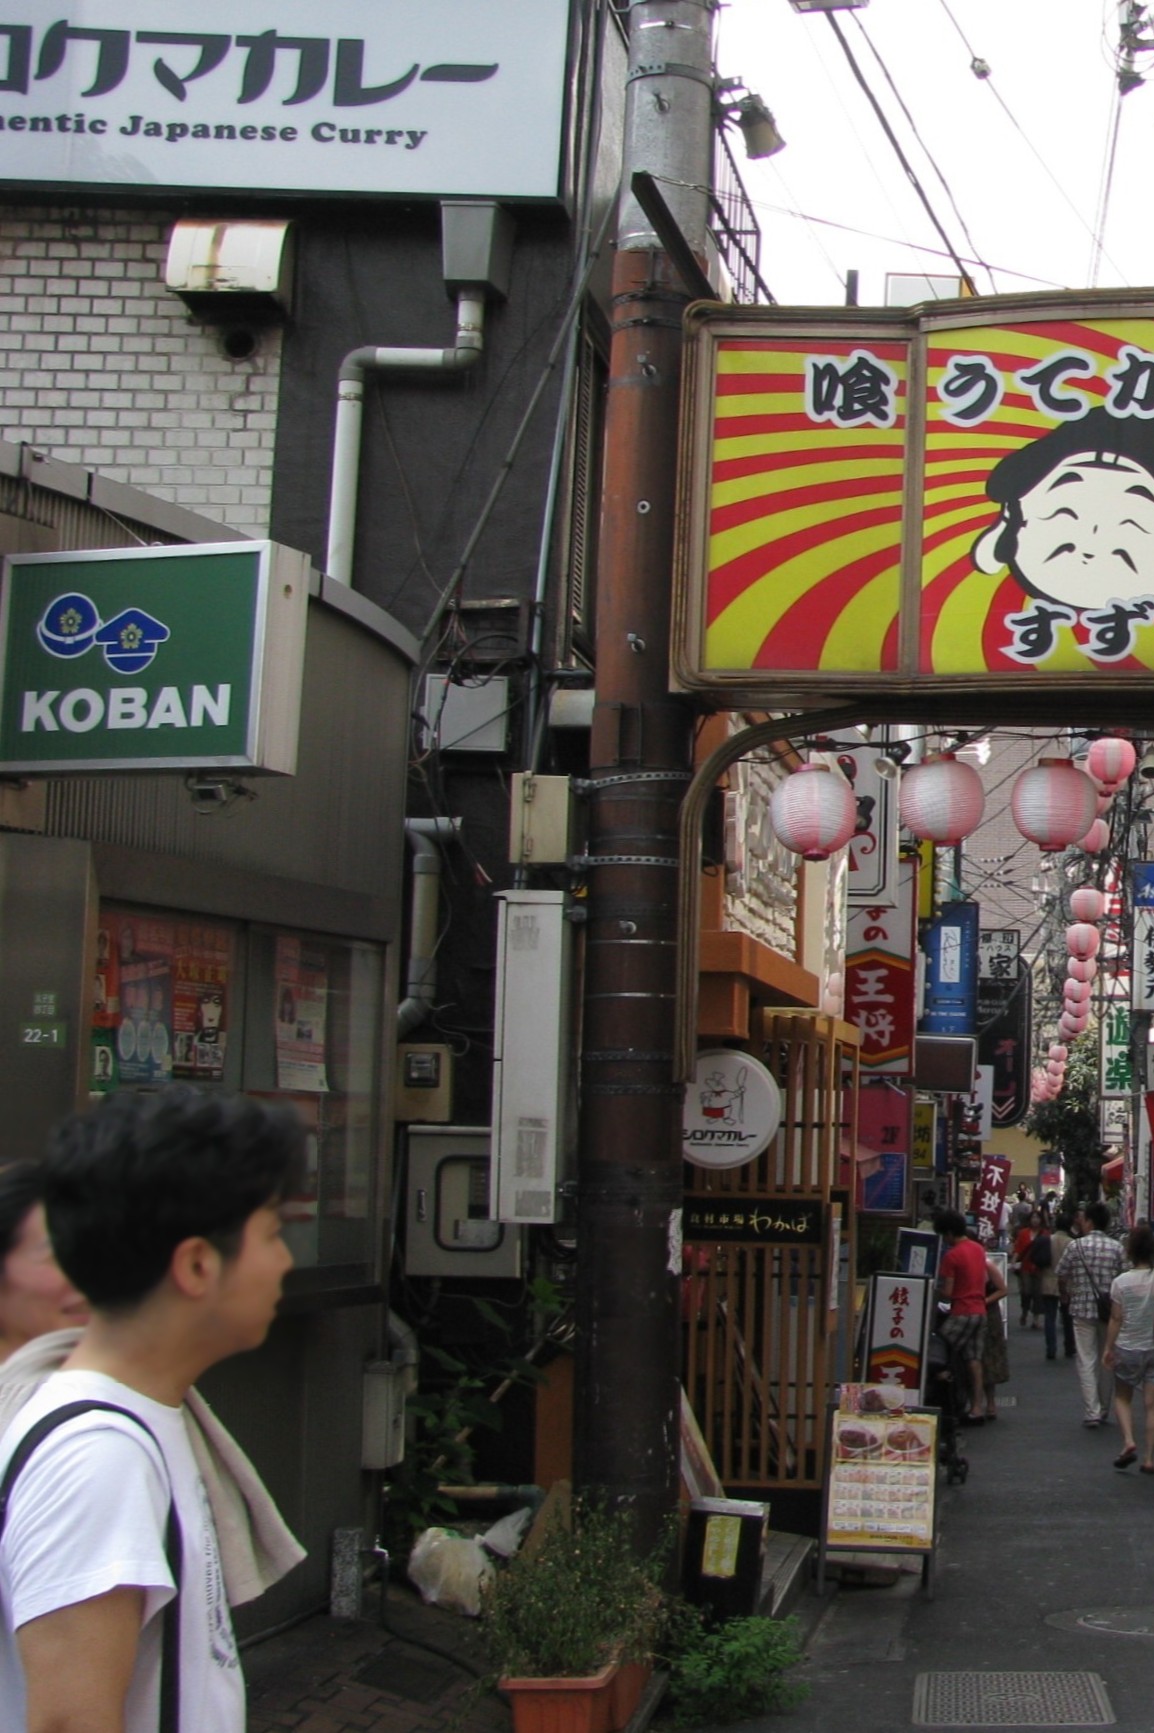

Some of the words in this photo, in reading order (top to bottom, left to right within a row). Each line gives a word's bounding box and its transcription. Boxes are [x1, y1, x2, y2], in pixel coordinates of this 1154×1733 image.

[119, 115, 298, 142] Japanese
[311, 121, 428, 150] Curry
[21, 683, 231, 733] KOBAN
[851, 968, 896, 1047] 王将
[24, 1028, 58, 1043] 22-1
[748, 1205, 814, 1235] わかば
